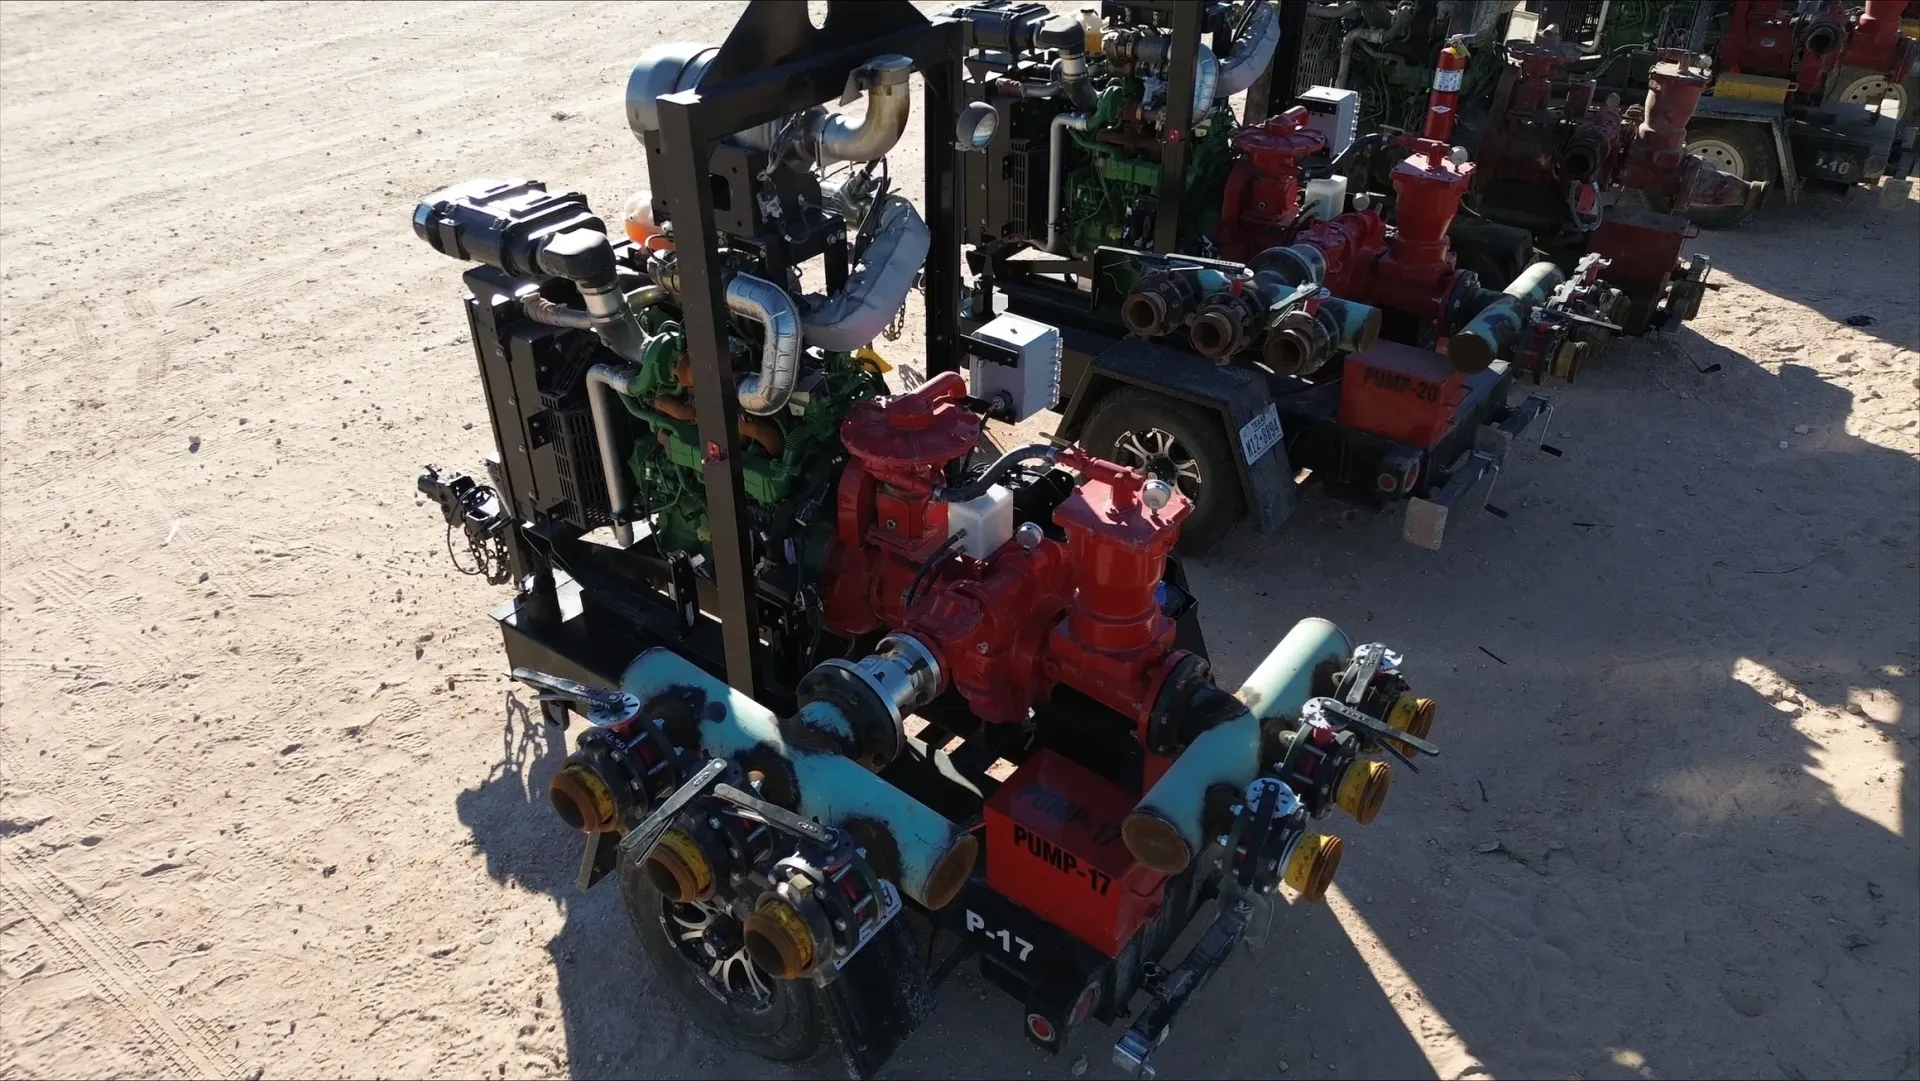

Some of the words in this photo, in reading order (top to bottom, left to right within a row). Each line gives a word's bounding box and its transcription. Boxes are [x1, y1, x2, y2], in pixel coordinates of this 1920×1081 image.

[1363, 366, 1441, 403] PUMP-20
[1251, 413, 1266, 429] TEXAS
[1013, 824, 1112, 896] PUMP-17
[966, 909, 1034, 962] P-17
